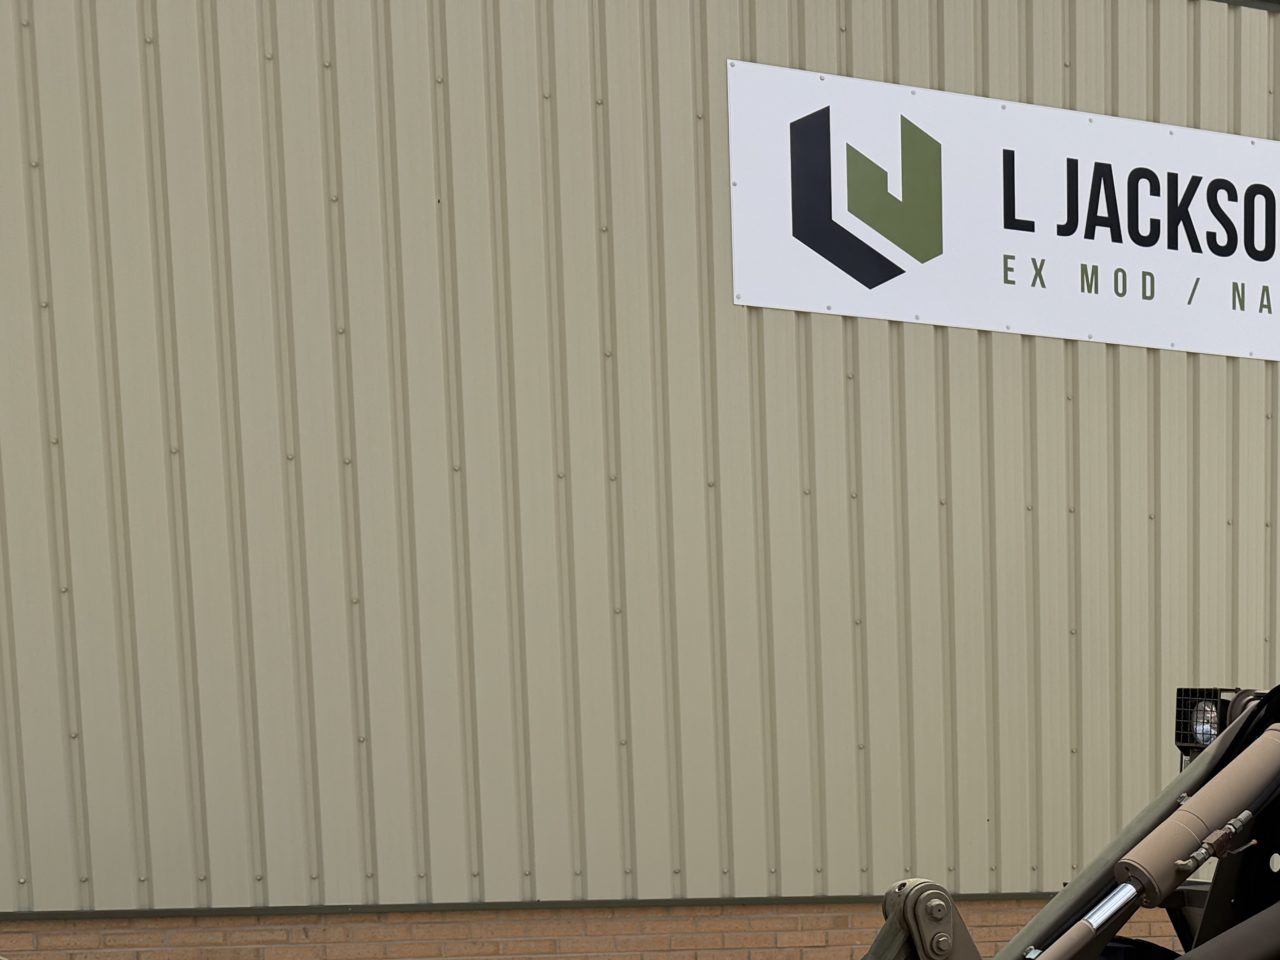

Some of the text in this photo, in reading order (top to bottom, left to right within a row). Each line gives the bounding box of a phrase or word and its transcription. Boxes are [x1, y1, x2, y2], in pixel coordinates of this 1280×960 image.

[1002, 148, 1035, 233] L
[1002, 254, 1046, 289] EX
[1080, 263, 1155, 301] MOD
